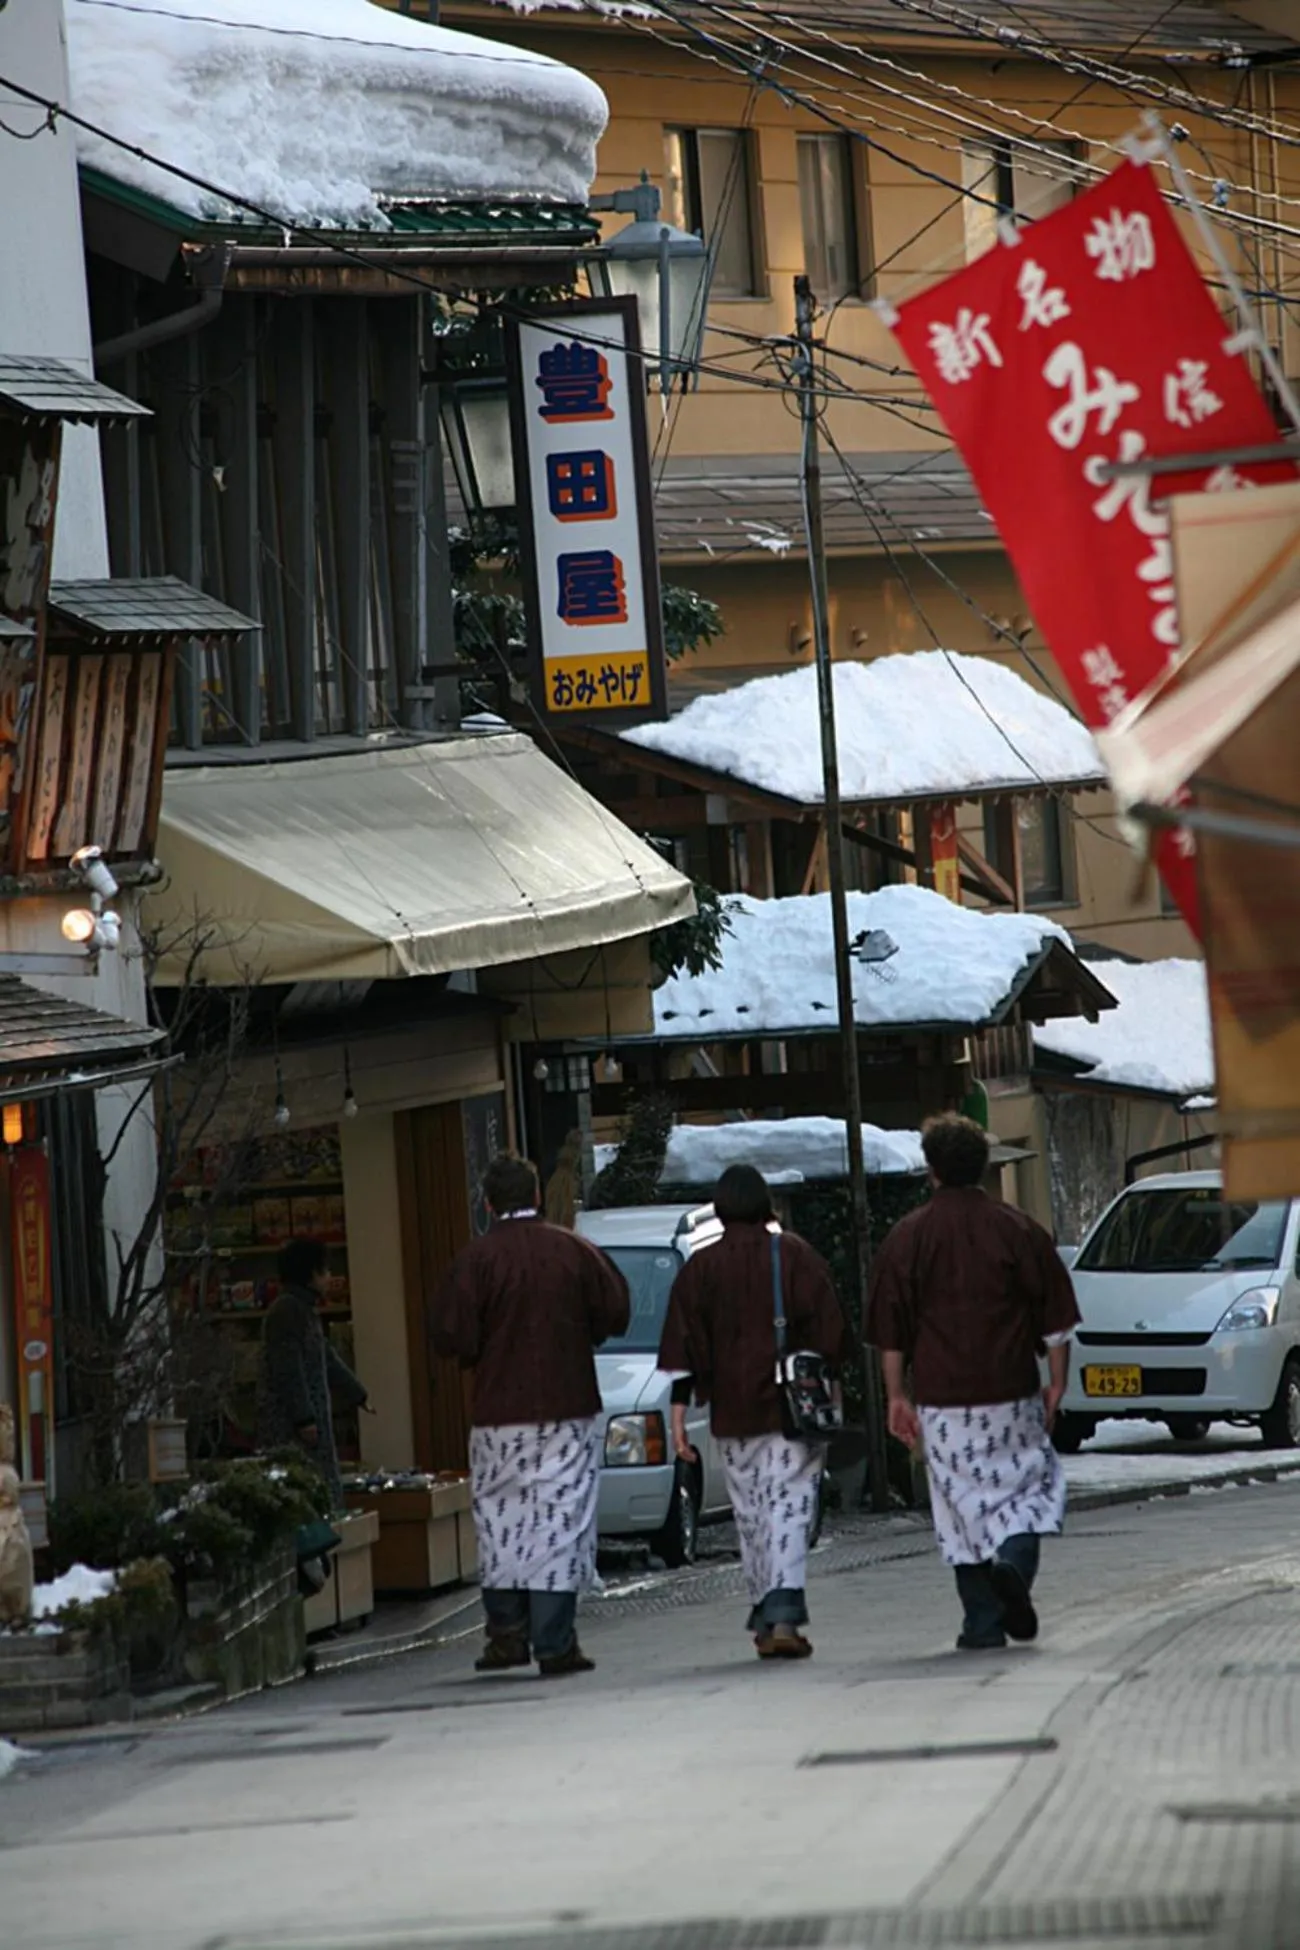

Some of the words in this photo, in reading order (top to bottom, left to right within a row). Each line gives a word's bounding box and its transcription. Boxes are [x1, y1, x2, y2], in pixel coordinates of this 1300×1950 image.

[928, 207, 1155, 384] 新名物
[536, 341, 628, 627] 豊田屋
[551, 662, 644, 706] おみやげ
